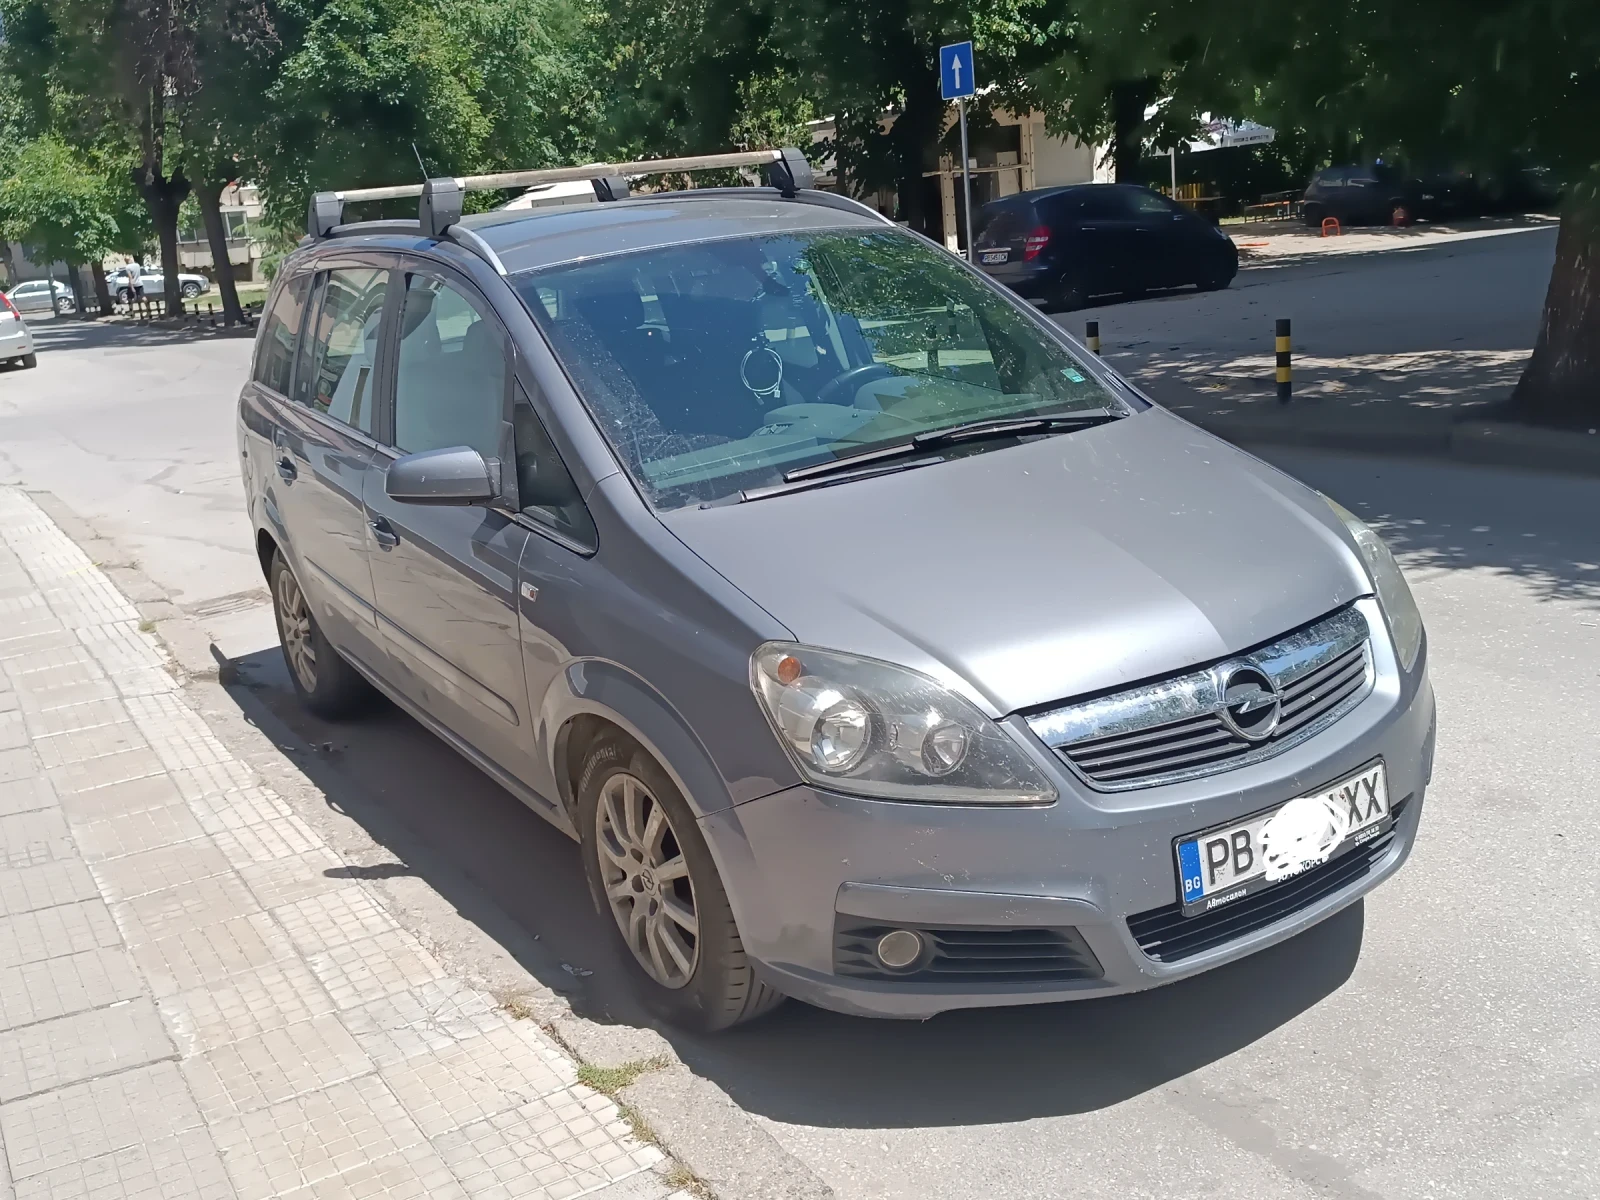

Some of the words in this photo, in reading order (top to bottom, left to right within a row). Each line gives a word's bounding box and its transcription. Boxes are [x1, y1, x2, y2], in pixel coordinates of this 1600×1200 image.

[1205, 829, 1254, 886] PB
[1343, 771, 1383, 828] XX
[1185, 875, 1201, 893] BG
